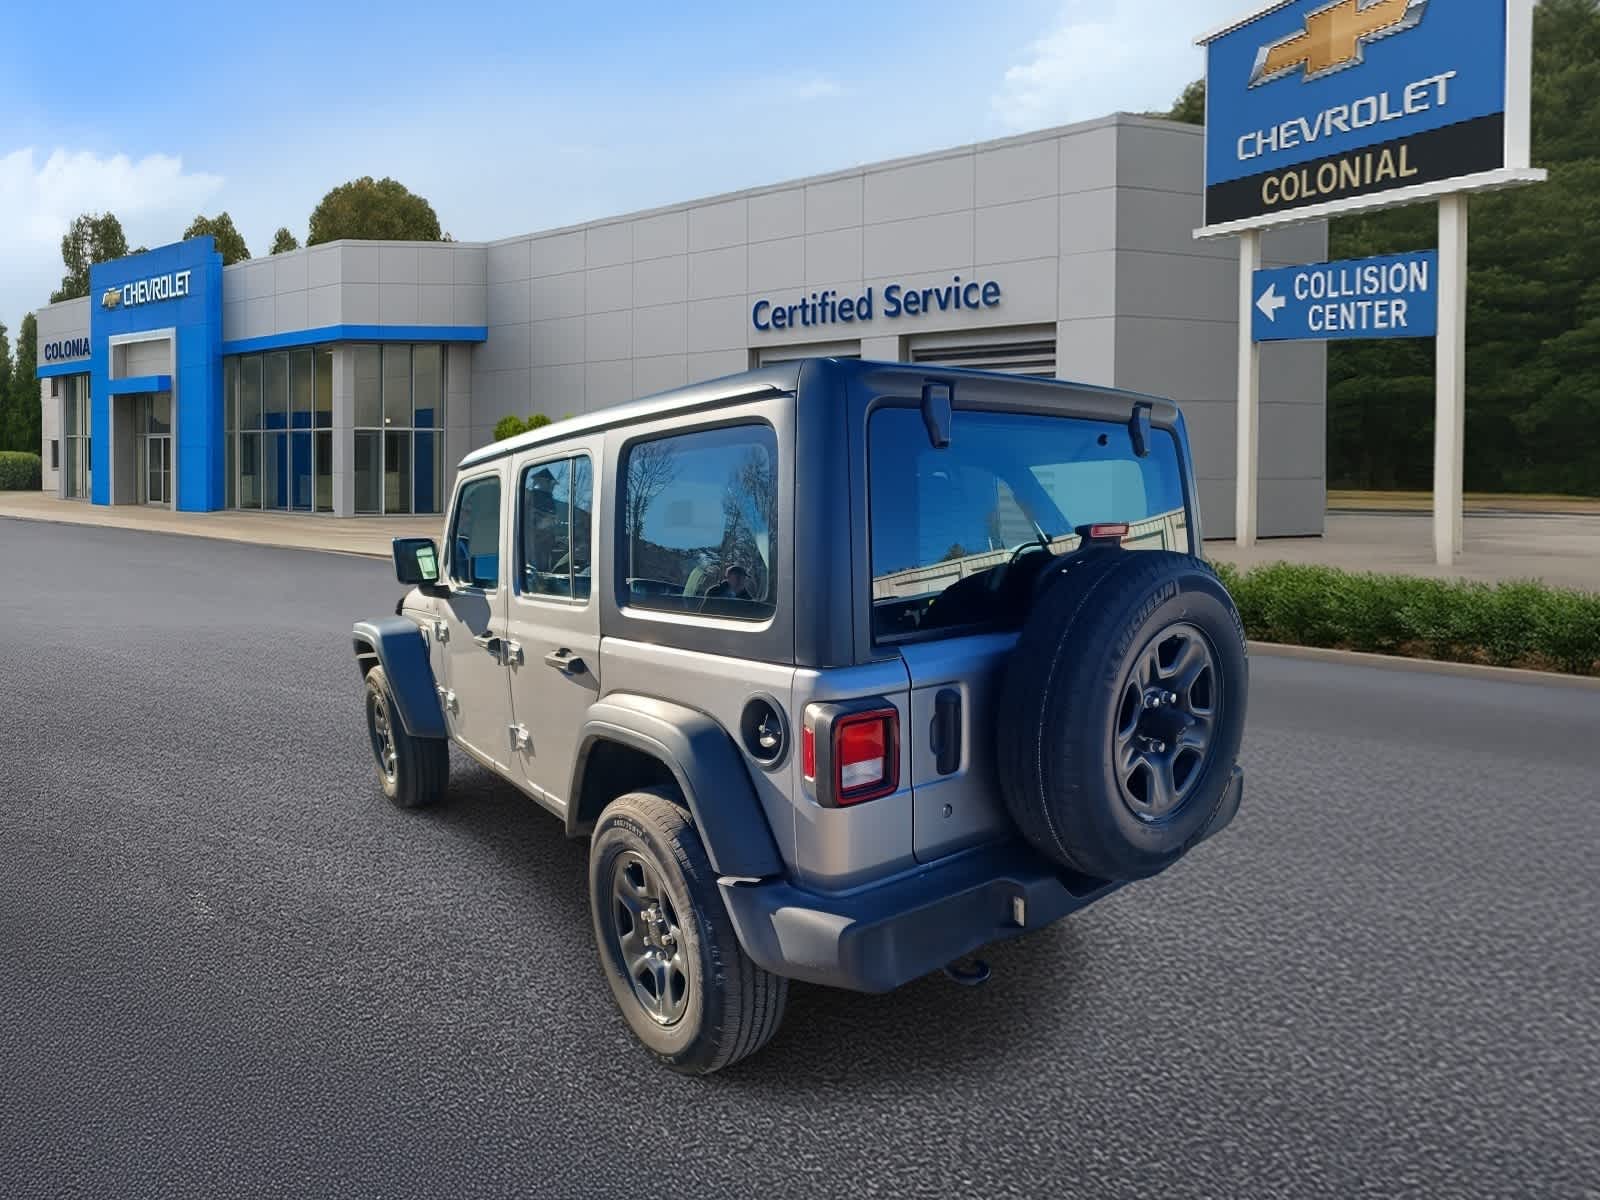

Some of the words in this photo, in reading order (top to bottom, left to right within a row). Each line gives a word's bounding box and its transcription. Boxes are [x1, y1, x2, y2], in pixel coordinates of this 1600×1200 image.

[1237, 70, 1456, 161] CHEVROLET
[1261, 145, 1418, 205] COLONIAL
[123, 270, 191, 306] CHEVROLET
[752, 287, 873, 330] Certified
[884, 276, 1001, 318] Service
[1294, 260, 1428, 301] COLLISION
[1308, 299, 1408, 331] CENTER
